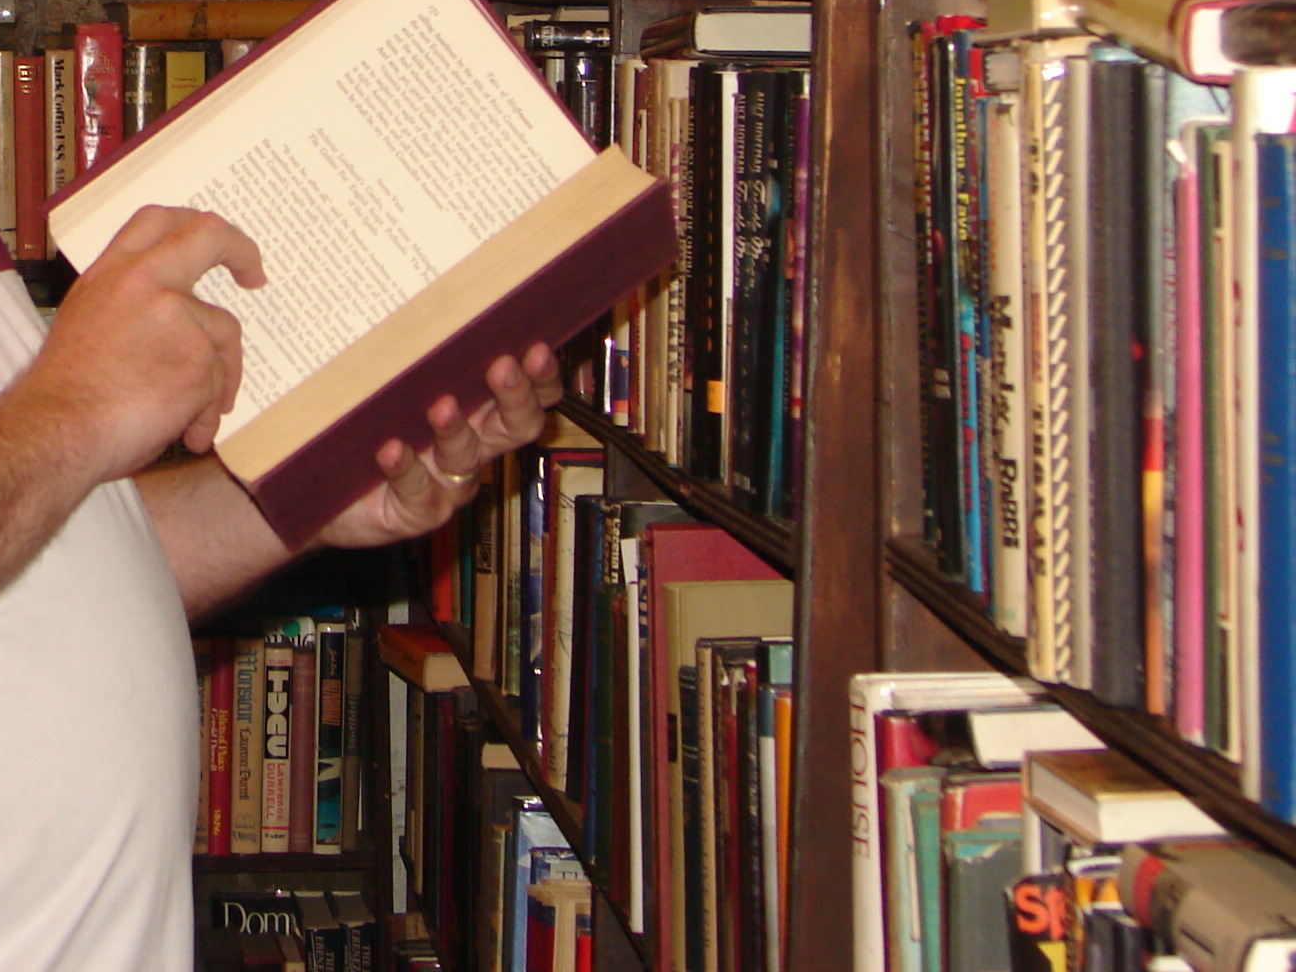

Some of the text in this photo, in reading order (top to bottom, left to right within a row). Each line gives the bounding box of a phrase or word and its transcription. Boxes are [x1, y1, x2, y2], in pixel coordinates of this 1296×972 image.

[54, 57, 66, 92] Mark
[54, 93, 66, 133] Coffin
[754, 90, 767, 118] ALICE
[751, 121, 766, 174] HOFFMAN
[236, 648, 259, 725] Monsieur
[265, 762, 276, 820] DURRELL
[276, 762, 287, 821] Lawrence
[851, 703, 871, 860] HOUSE
